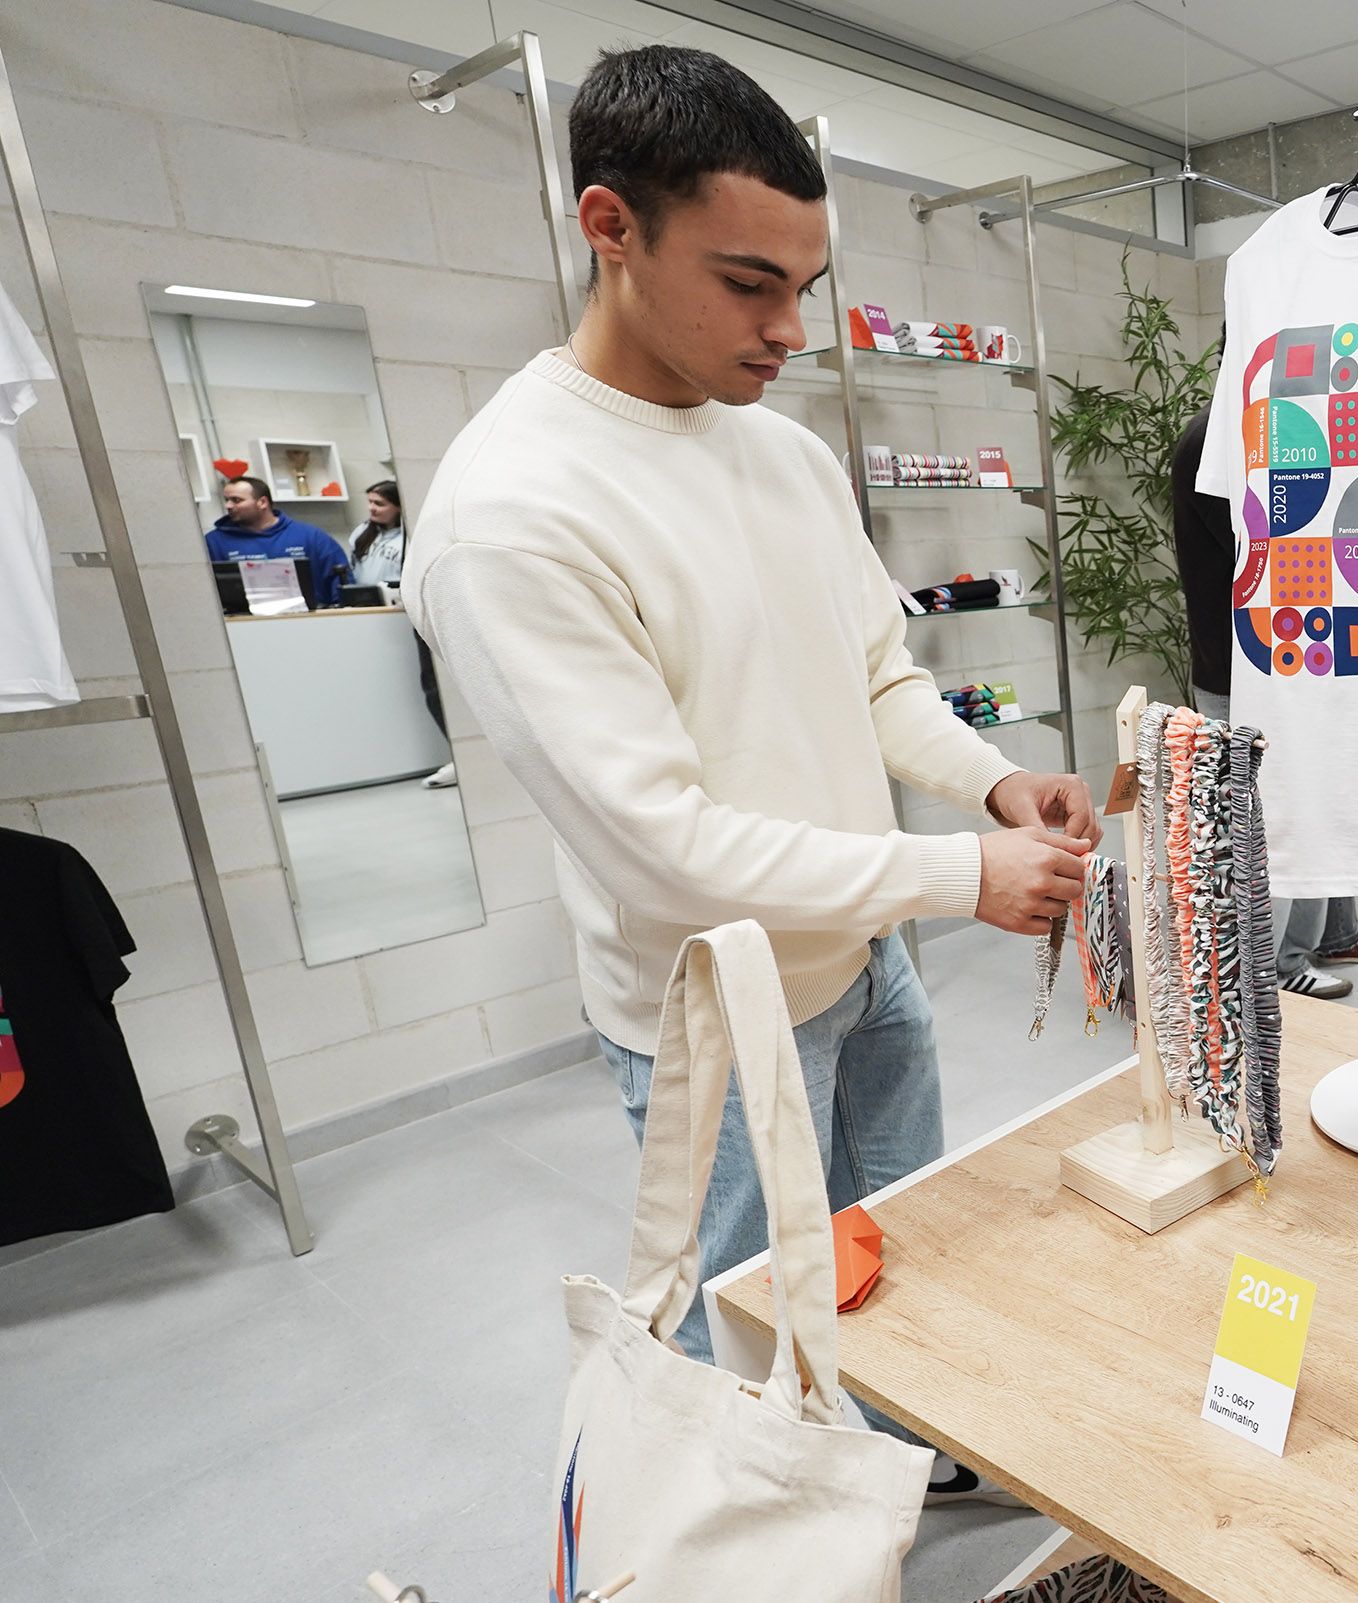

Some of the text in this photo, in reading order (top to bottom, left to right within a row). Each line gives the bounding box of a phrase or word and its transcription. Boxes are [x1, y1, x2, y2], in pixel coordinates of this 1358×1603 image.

[979, 450, 1001, 459] 2015
[1281, 447, 1317, 463] 2010
[1301, 472, 1325, 480] 19-4052
[1273, 484, 1287, 524] 2020
[1250, 541, 1267, 552] 2023
[1237, 1274, 1300, 1322] 2021
[1213, 1385, 1225, 1399] 13
[1231, 1393, 1255, 1411] 0647
[1209, 1400, 1259, 1433] Illuminating
